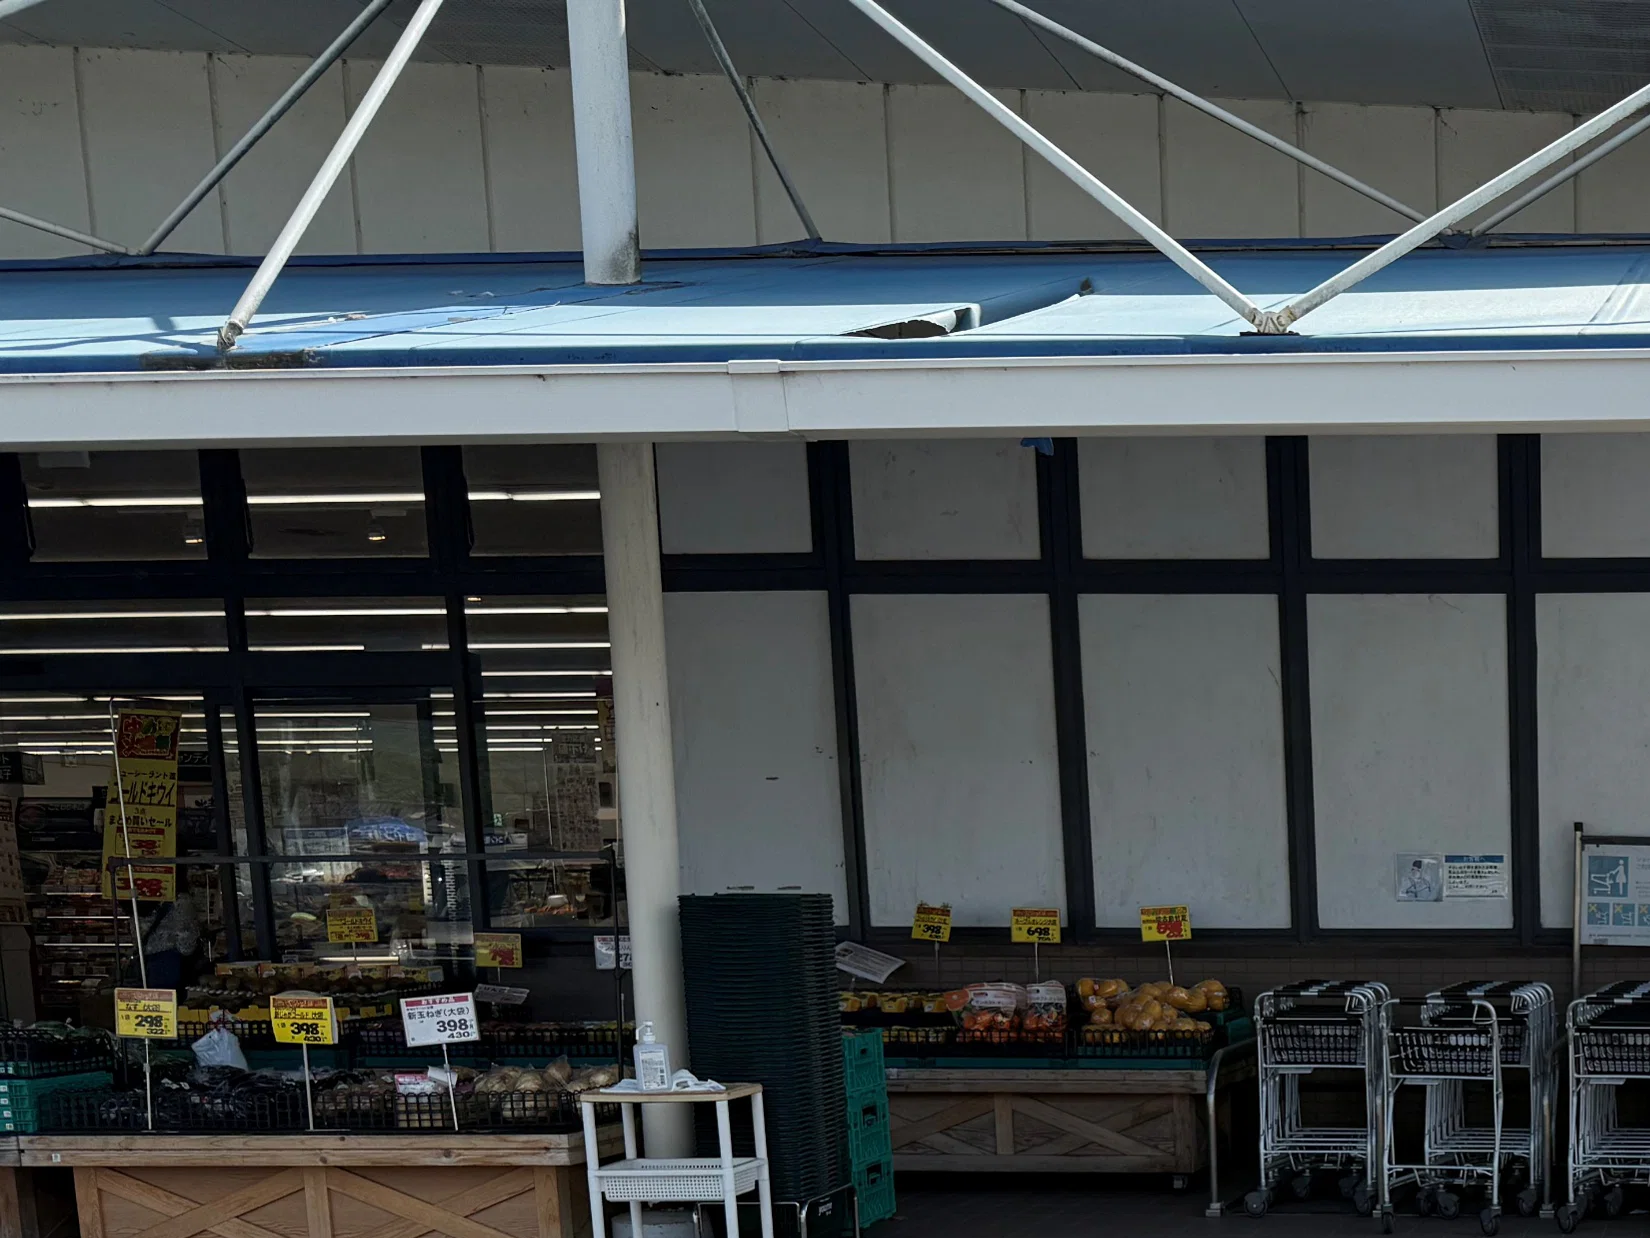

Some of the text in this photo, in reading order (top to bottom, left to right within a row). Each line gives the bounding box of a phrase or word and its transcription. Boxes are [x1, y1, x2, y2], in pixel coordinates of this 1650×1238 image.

[109, 779, 175, 805] ゴールドキウイ
[109, 816, 172, 828] まとめ買いセール
[923, 923, 941, 934] 398
[1027, 926, 1050, 936] 698
[135, 1014, 163, 1027] 298
[436, 1018, 469, 1032] 398
[290, 1022, 319, 1035] 398
[447, 1031, 470, 1039] 430
